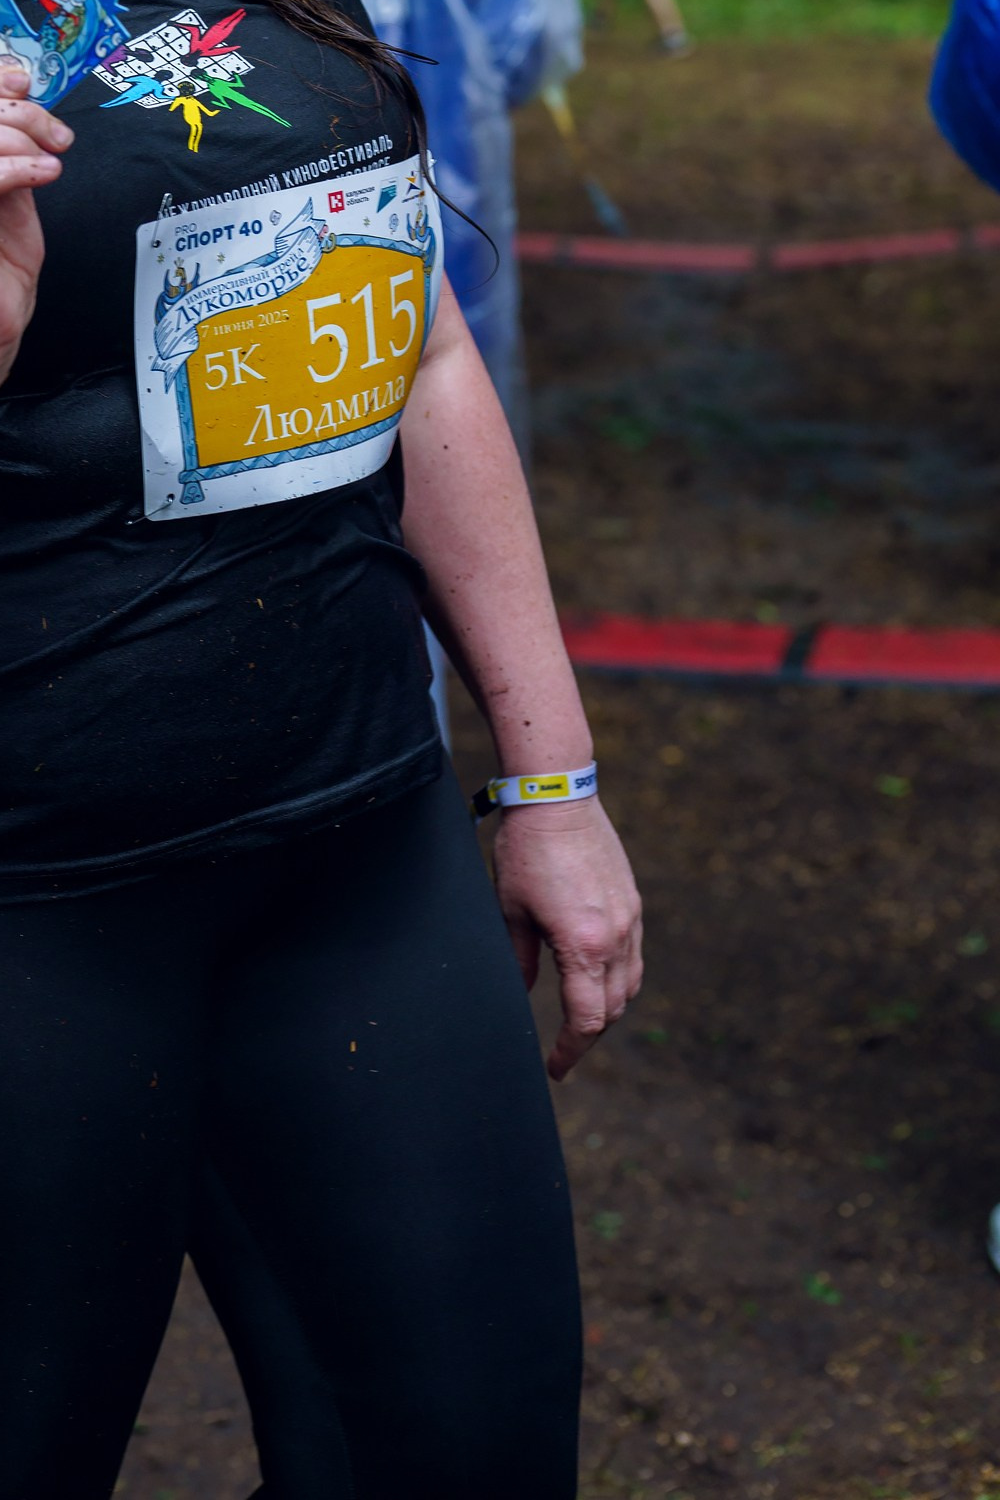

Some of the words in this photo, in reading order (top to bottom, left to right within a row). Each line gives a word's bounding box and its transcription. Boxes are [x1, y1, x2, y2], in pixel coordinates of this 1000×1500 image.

[281, 134, 393, 188] КИНОФЕСТИВАЛЬ
[174, 222, 198, 236] PRO
[175, 224, 235, 252] СПОРТ
[239, 219, 264, 237] 40
[174, 255, 310, 333] Лукоморье
[185, 269, 270, 305] иммерсивный
[273, 248, 305, 279] трейл
[200, 324, 210, 338] 7
[213, 319, 255, 337] июня
[258, 309, 290, 328] 2025
[306, 269, 417, 384] 515
[243, 374, 406, 446] Людмила
